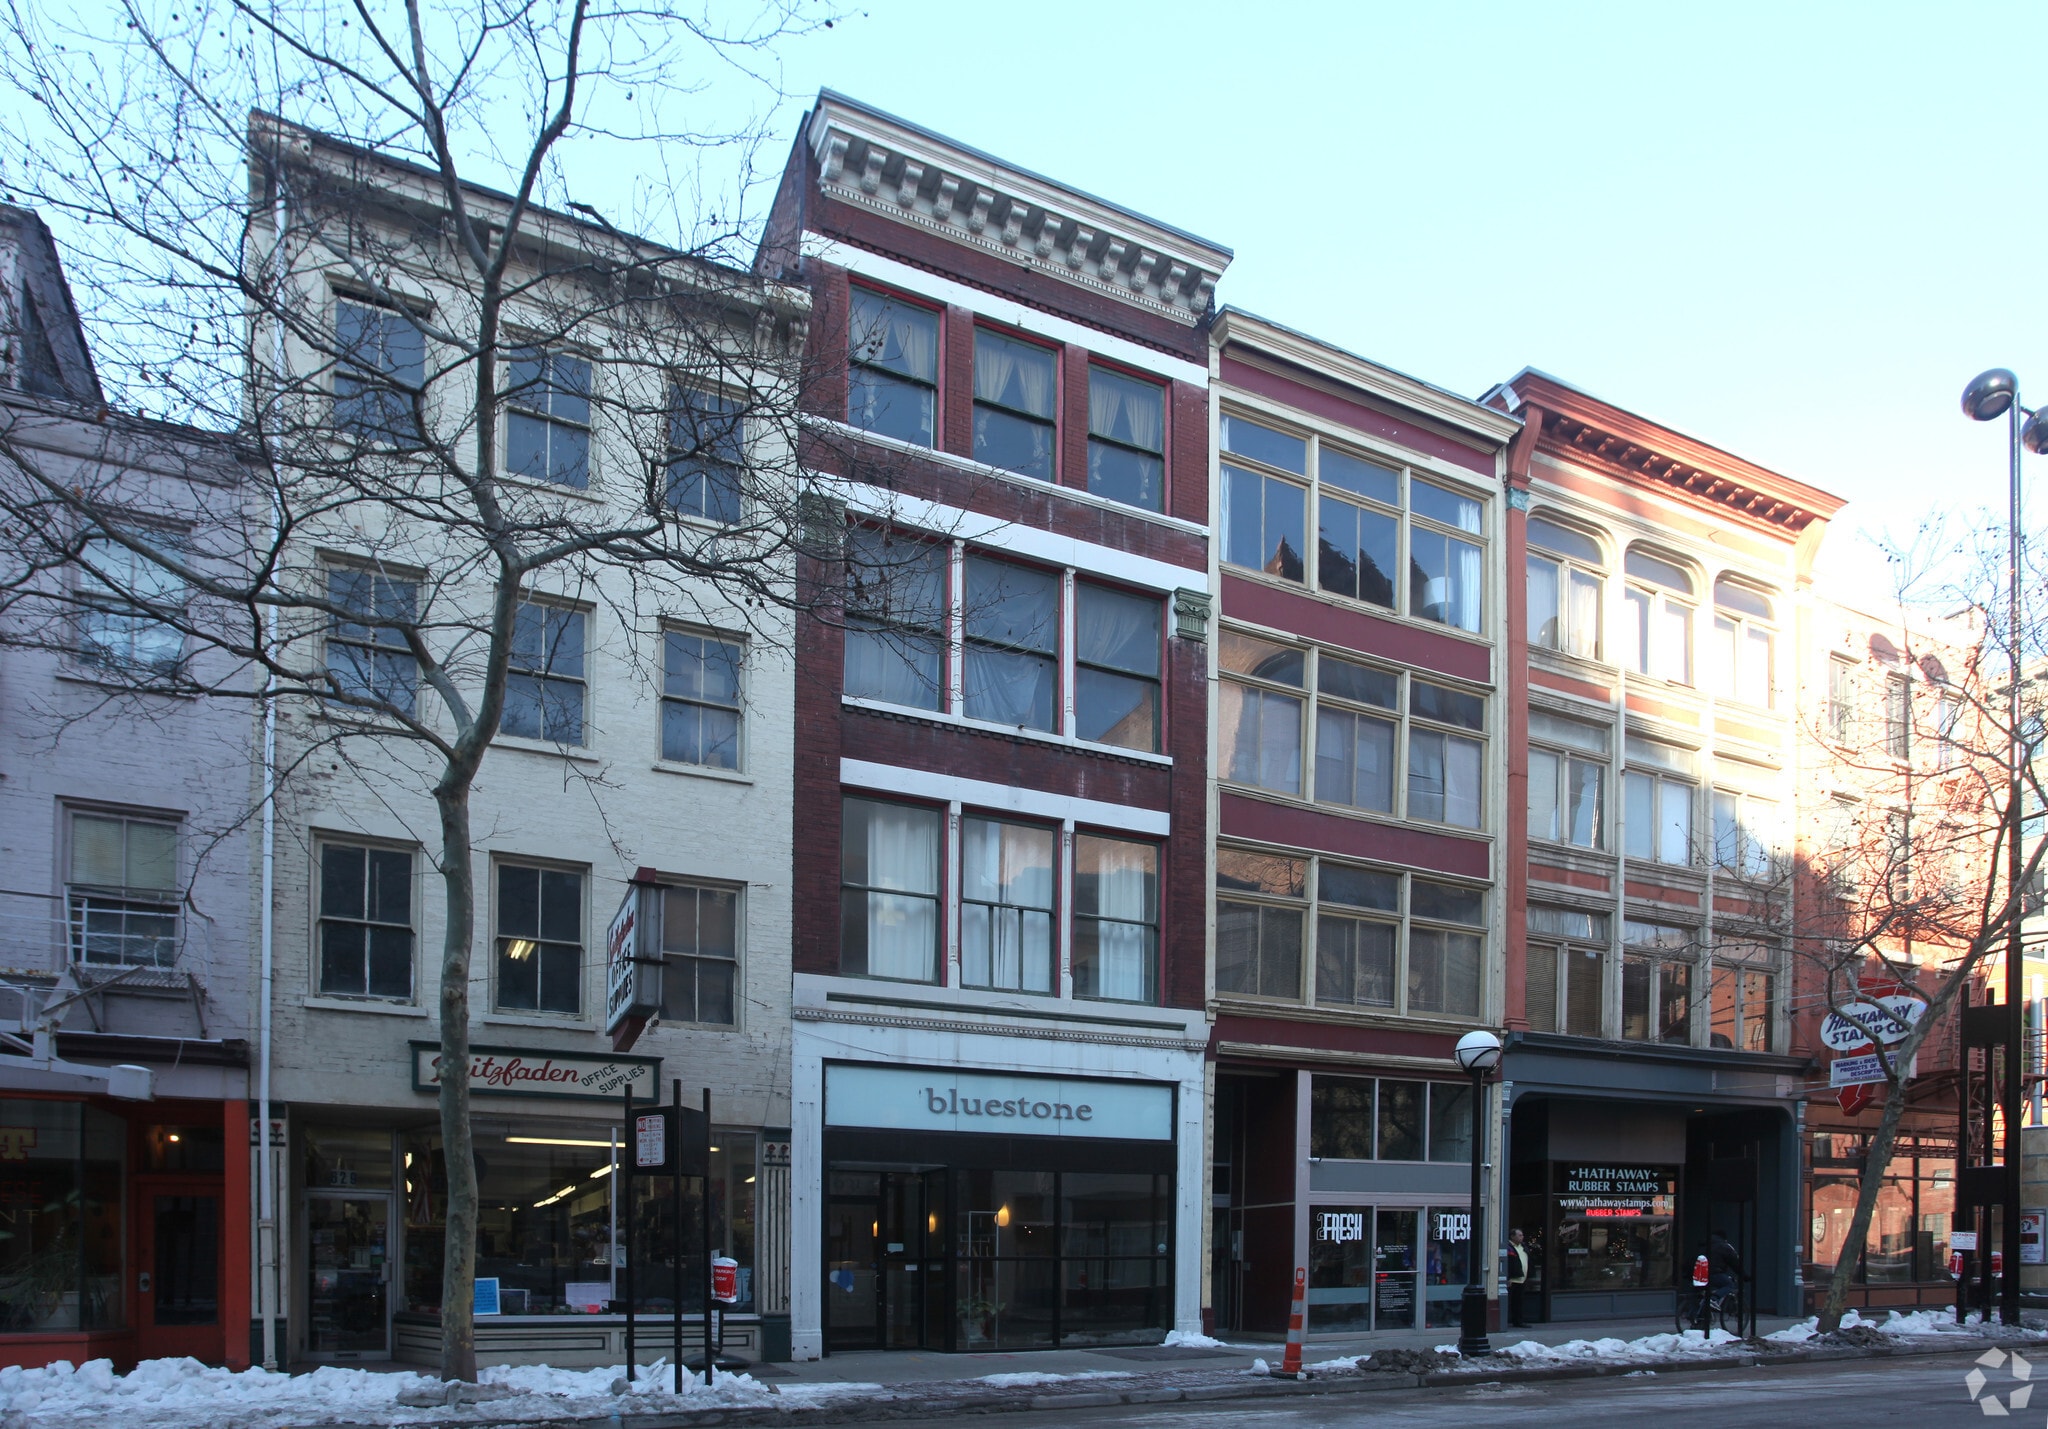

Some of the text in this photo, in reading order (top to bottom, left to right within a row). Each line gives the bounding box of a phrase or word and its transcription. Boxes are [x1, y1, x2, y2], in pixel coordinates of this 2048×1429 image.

[580, 1063, 618, 1088] OFFICE
[598, 1065, 646, 1094] SUPPLIES
[925, 1087, 1093, 1121] bluestone
[1578, 1167, 1651, 1180] HATHAWAY
[1568, 1180, 1659, 1193] RUBBER STAMPS
[1559, 1197, 1669, 1210] www.hathawaystamps.com
[1585, 1208, 1642, 1217] RUBBER STAMPS
